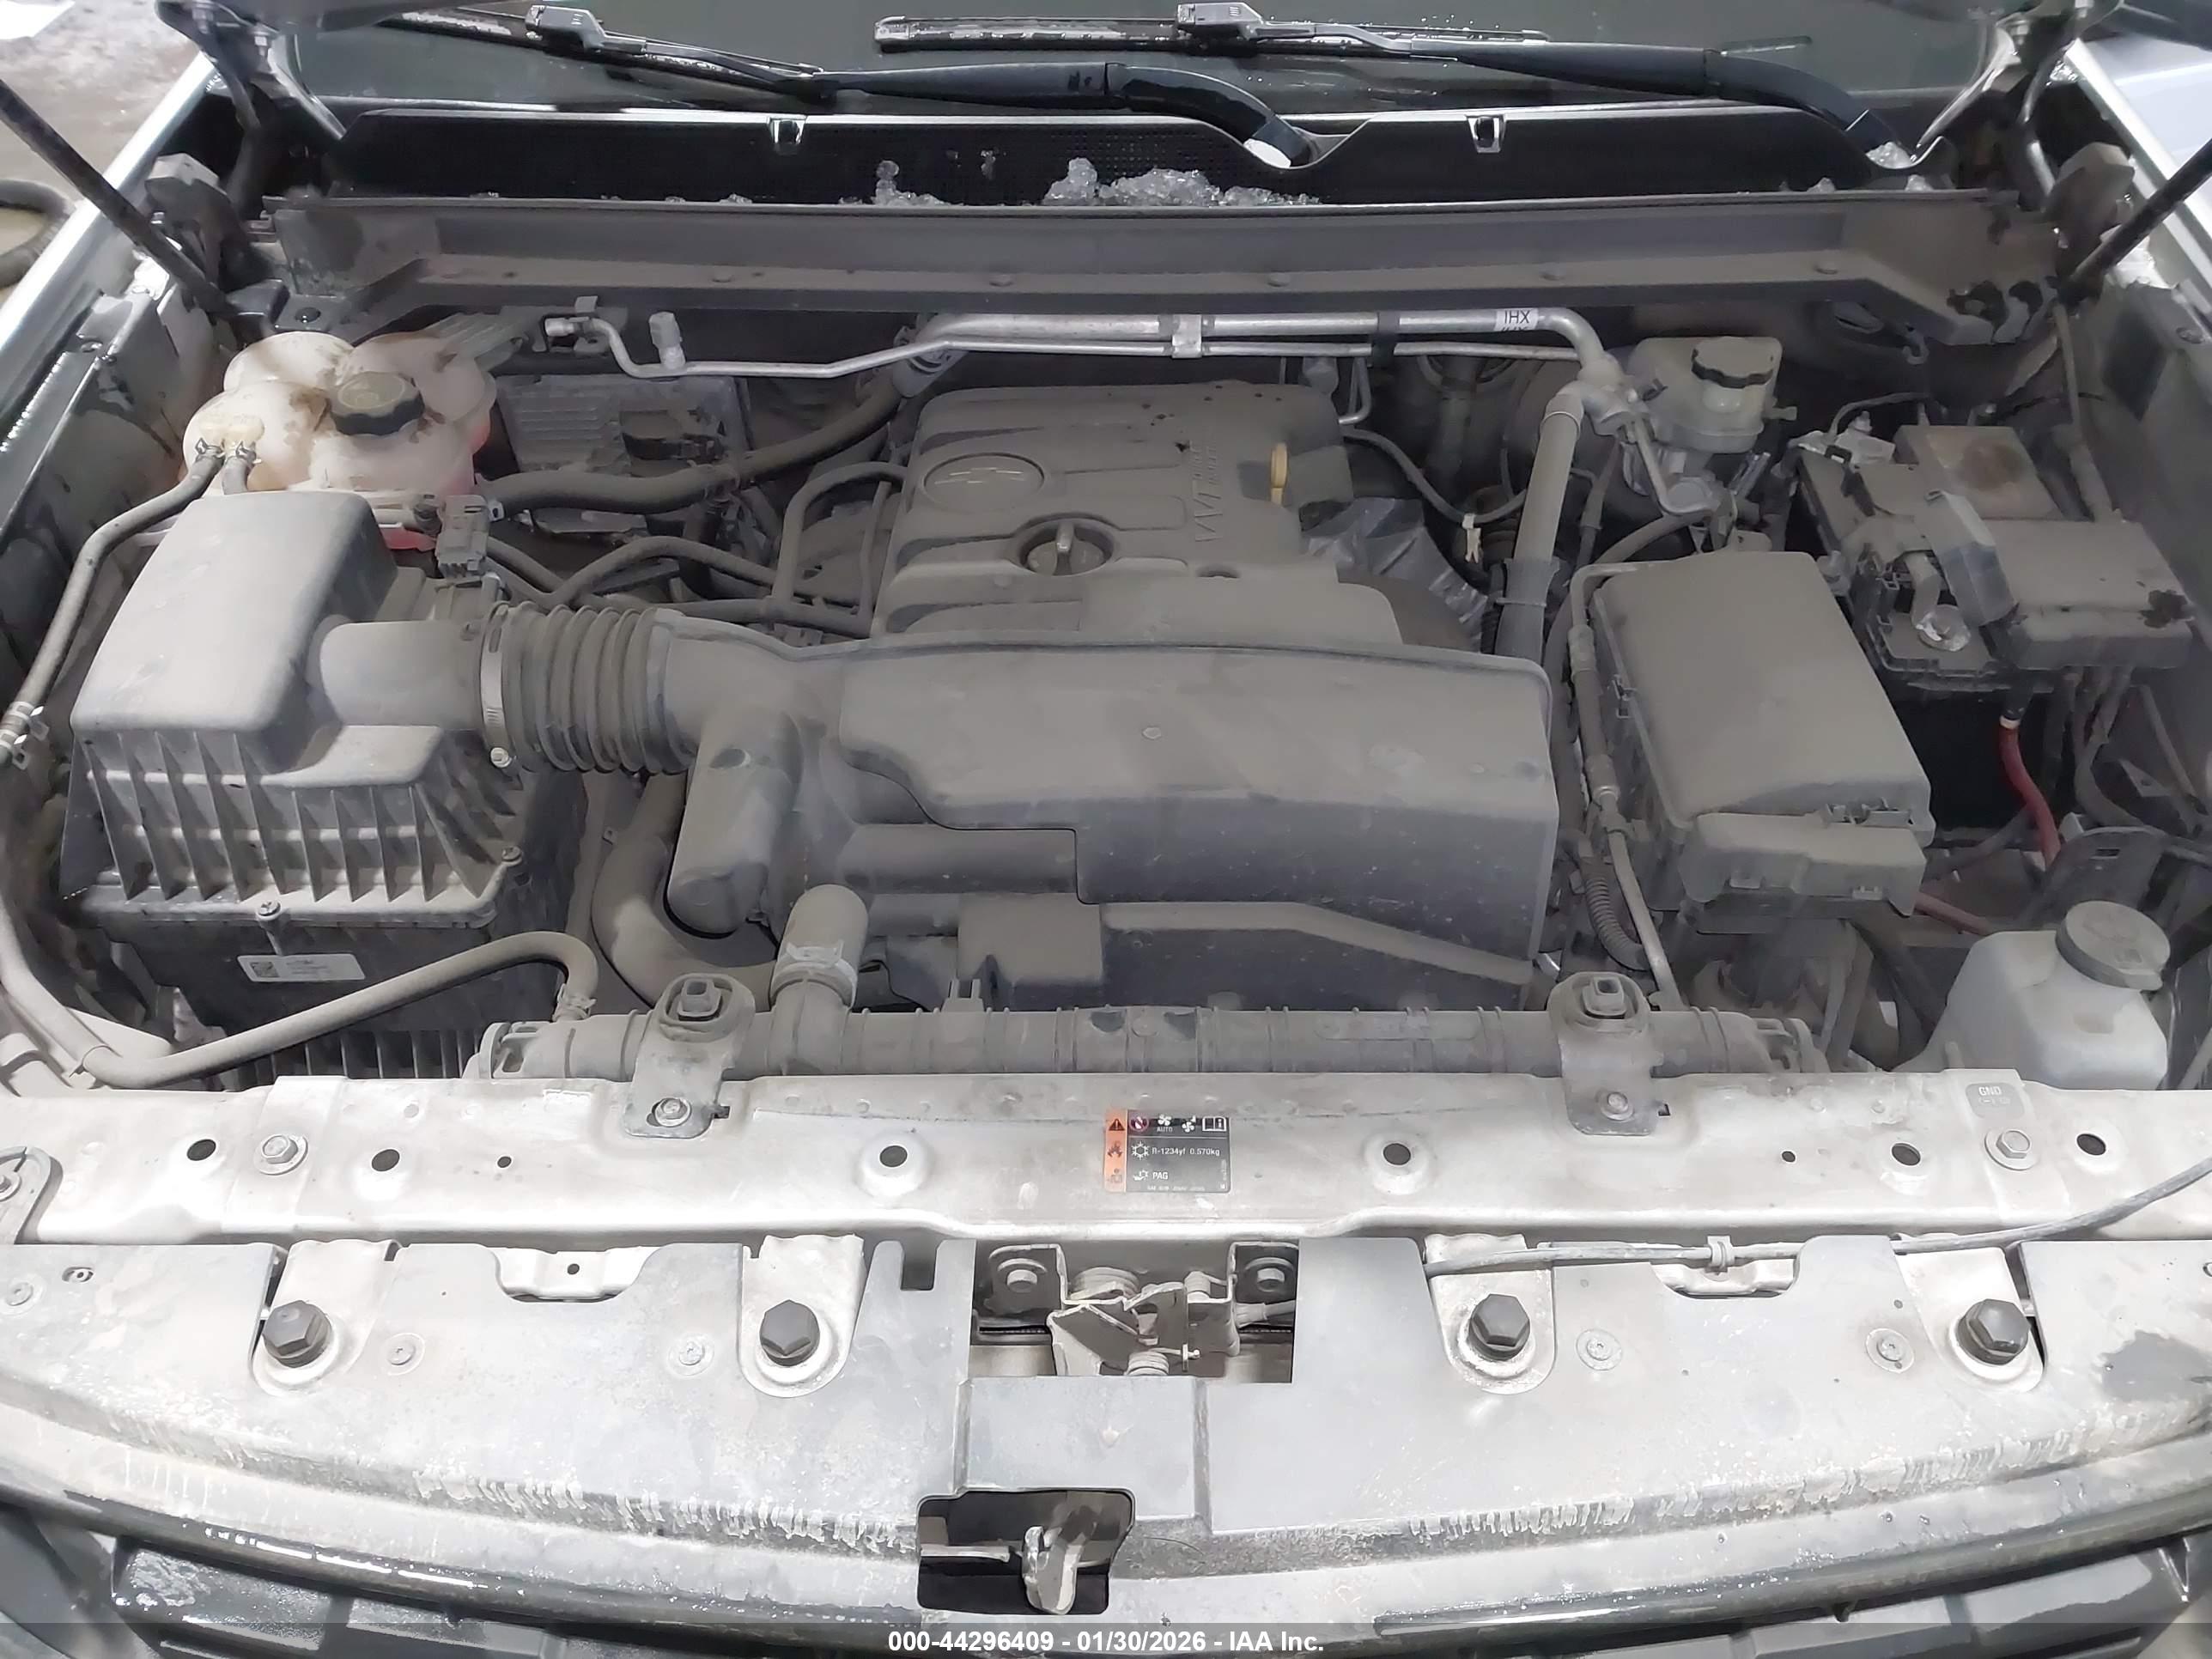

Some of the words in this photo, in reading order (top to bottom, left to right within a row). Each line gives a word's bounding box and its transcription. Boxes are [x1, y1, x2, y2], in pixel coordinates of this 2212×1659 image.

[1504, 310, 1531, 324] IHX
[1978, 1085, 2002, 1097] GND
[1152, 1146, 1186, 1157] R-1234yf
[1189, 1146, 1220, 1157] 0.570kg
[1152, 1171, 1169, 1181] PAG
